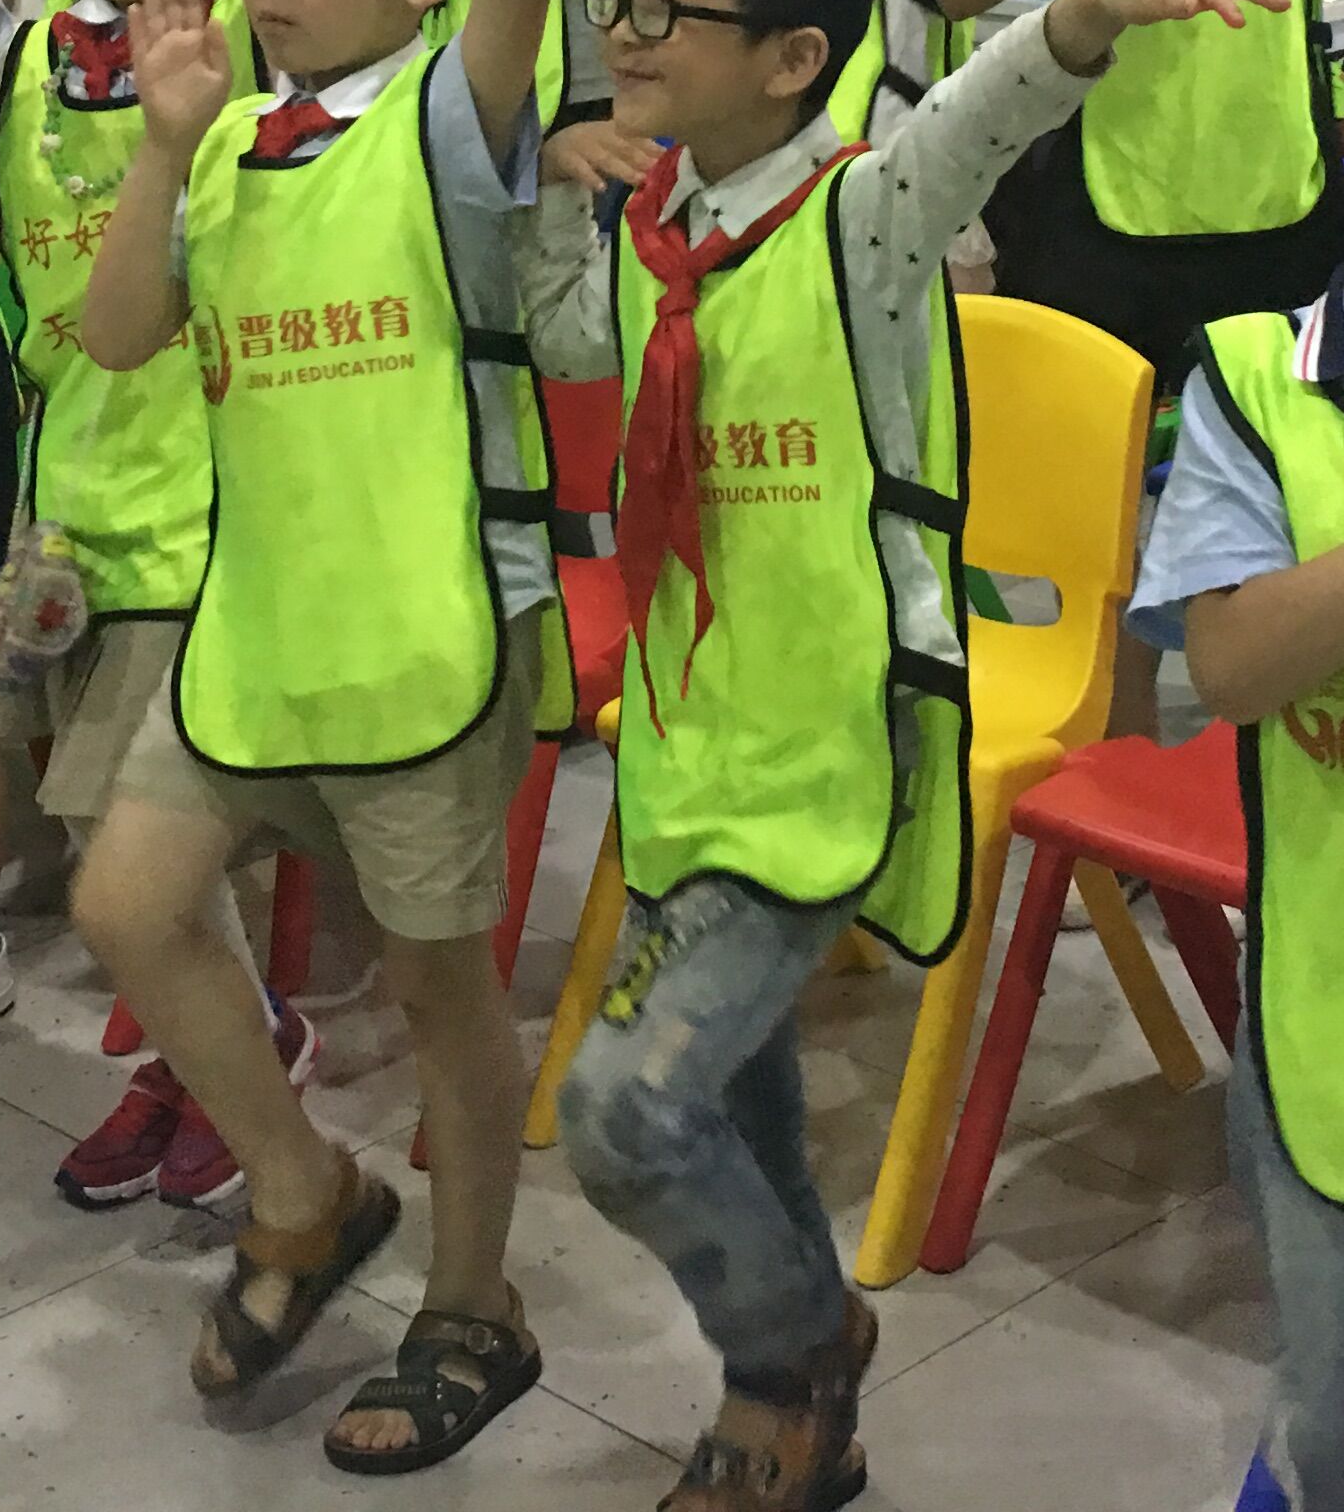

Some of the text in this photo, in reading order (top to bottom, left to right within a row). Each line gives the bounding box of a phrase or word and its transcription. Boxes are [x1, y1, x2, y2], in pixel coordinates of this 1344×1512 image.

[238, 295, 411, 360] 晋级教育
[246, 353, 415, 389] JIN JI EDUCATION
